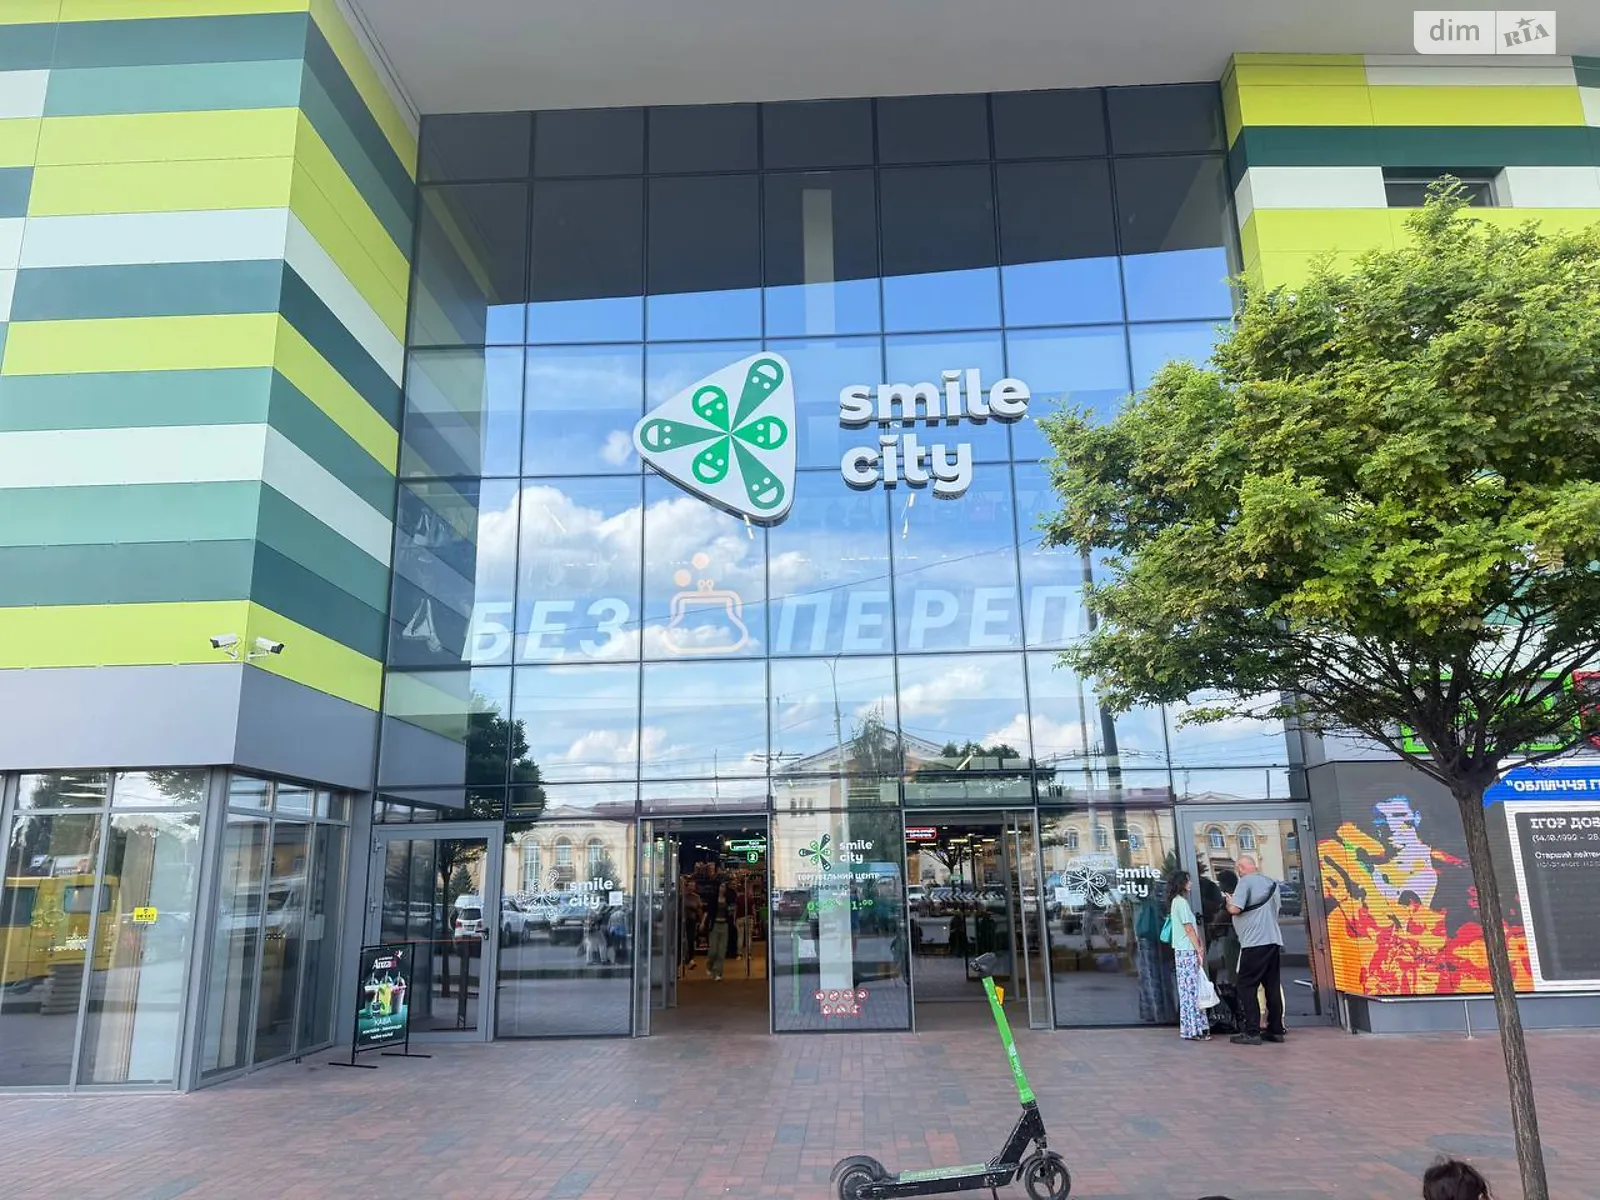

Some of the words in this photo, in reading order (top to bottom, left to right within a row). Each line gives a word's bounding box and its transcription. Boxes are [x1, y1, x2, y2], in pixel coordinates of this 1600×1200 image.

[839, 368, 1031, 429] smile
[840, 433, 973, 500] city
[461, 598, 630, 661] БЕЗ
[839, 840, 872, 850] smile
[840, 852, 864, 864] city
[1116, 864, 1161, 878] smile
[569, 877, 614, 891] smile
[1117, 881, 1148, 897] city
[569, 893, 600, 909] city
